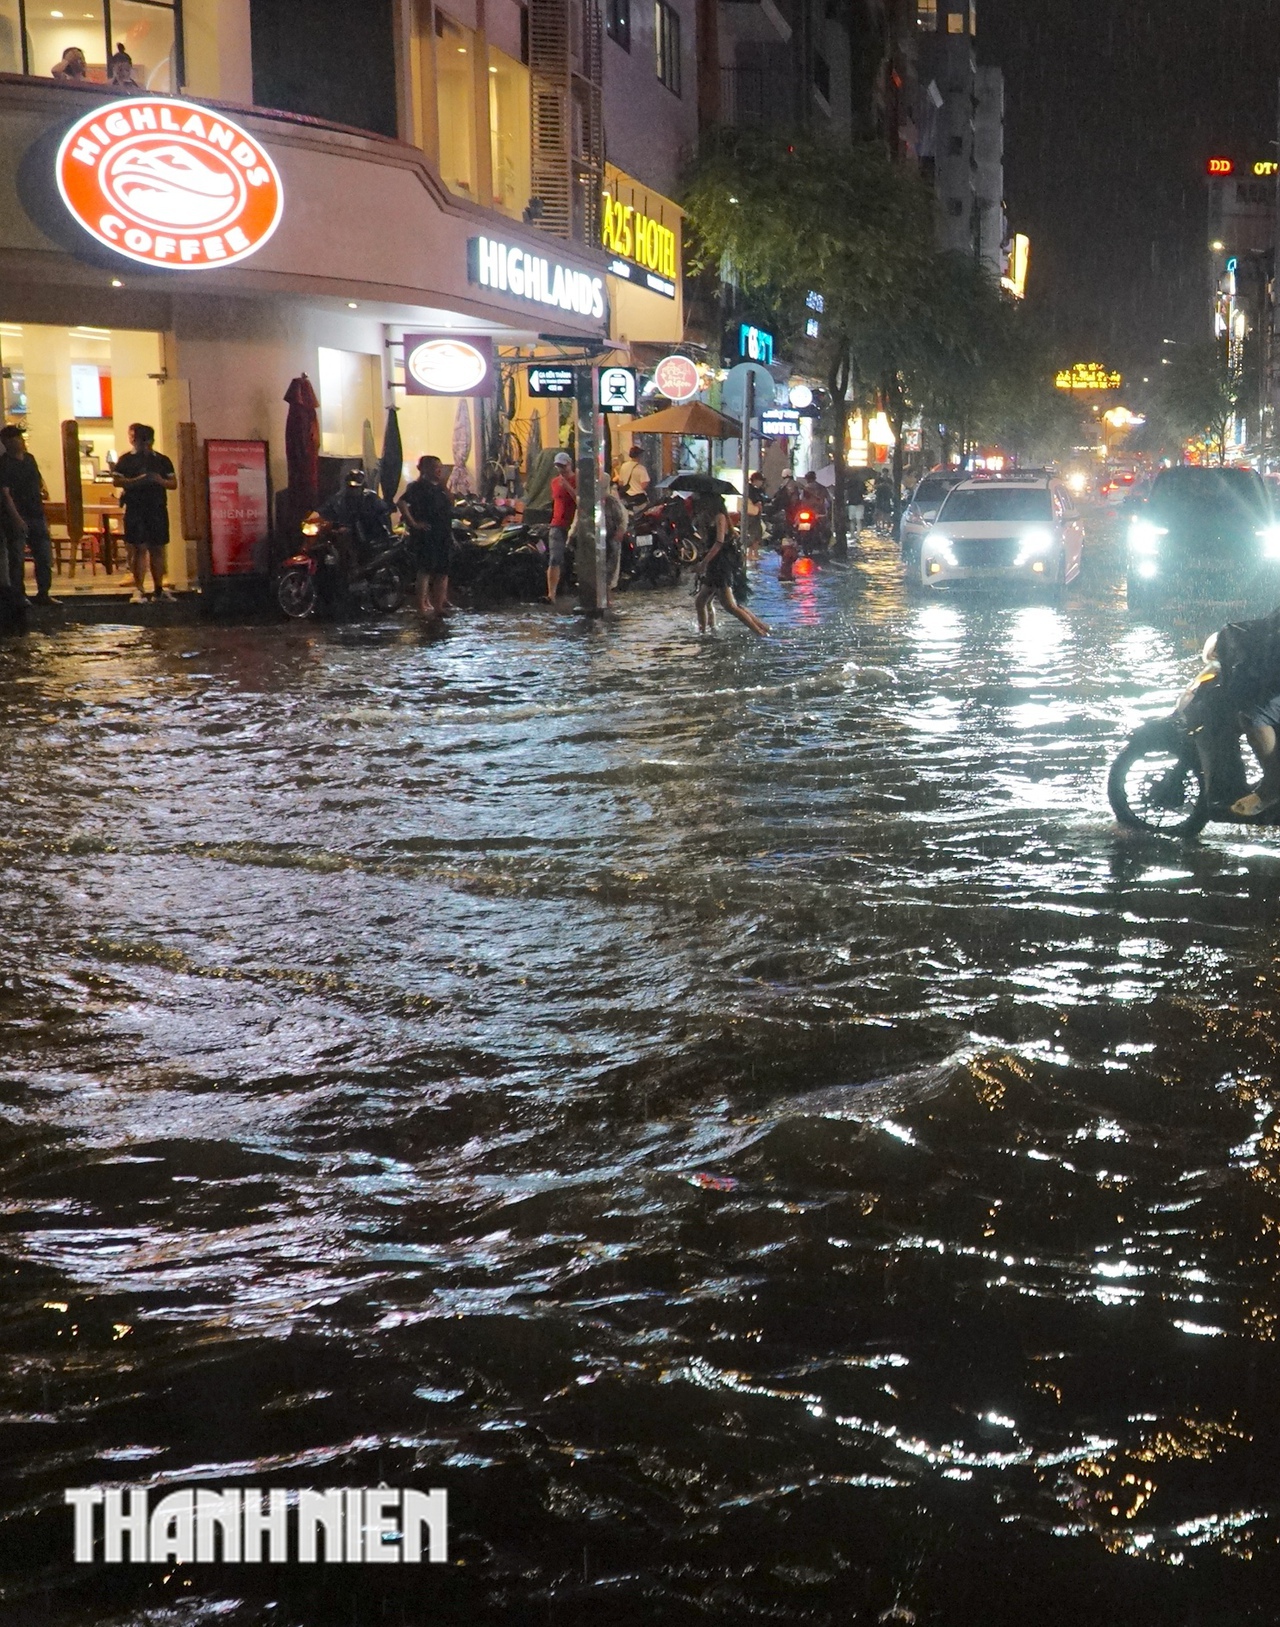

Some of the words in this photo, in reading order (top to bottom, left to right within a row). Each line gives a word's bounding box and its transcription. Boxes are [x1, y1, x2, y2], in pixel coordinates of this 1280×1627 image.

[71, 106, 270, 187] HIGHLANDS
[98, 213, 251, 262] COFFEE
[602, 191, 634, 257] A25
[635, 211, 677, 279] HOTEL
[478, 236, 604, 319] HIGHLANDS
